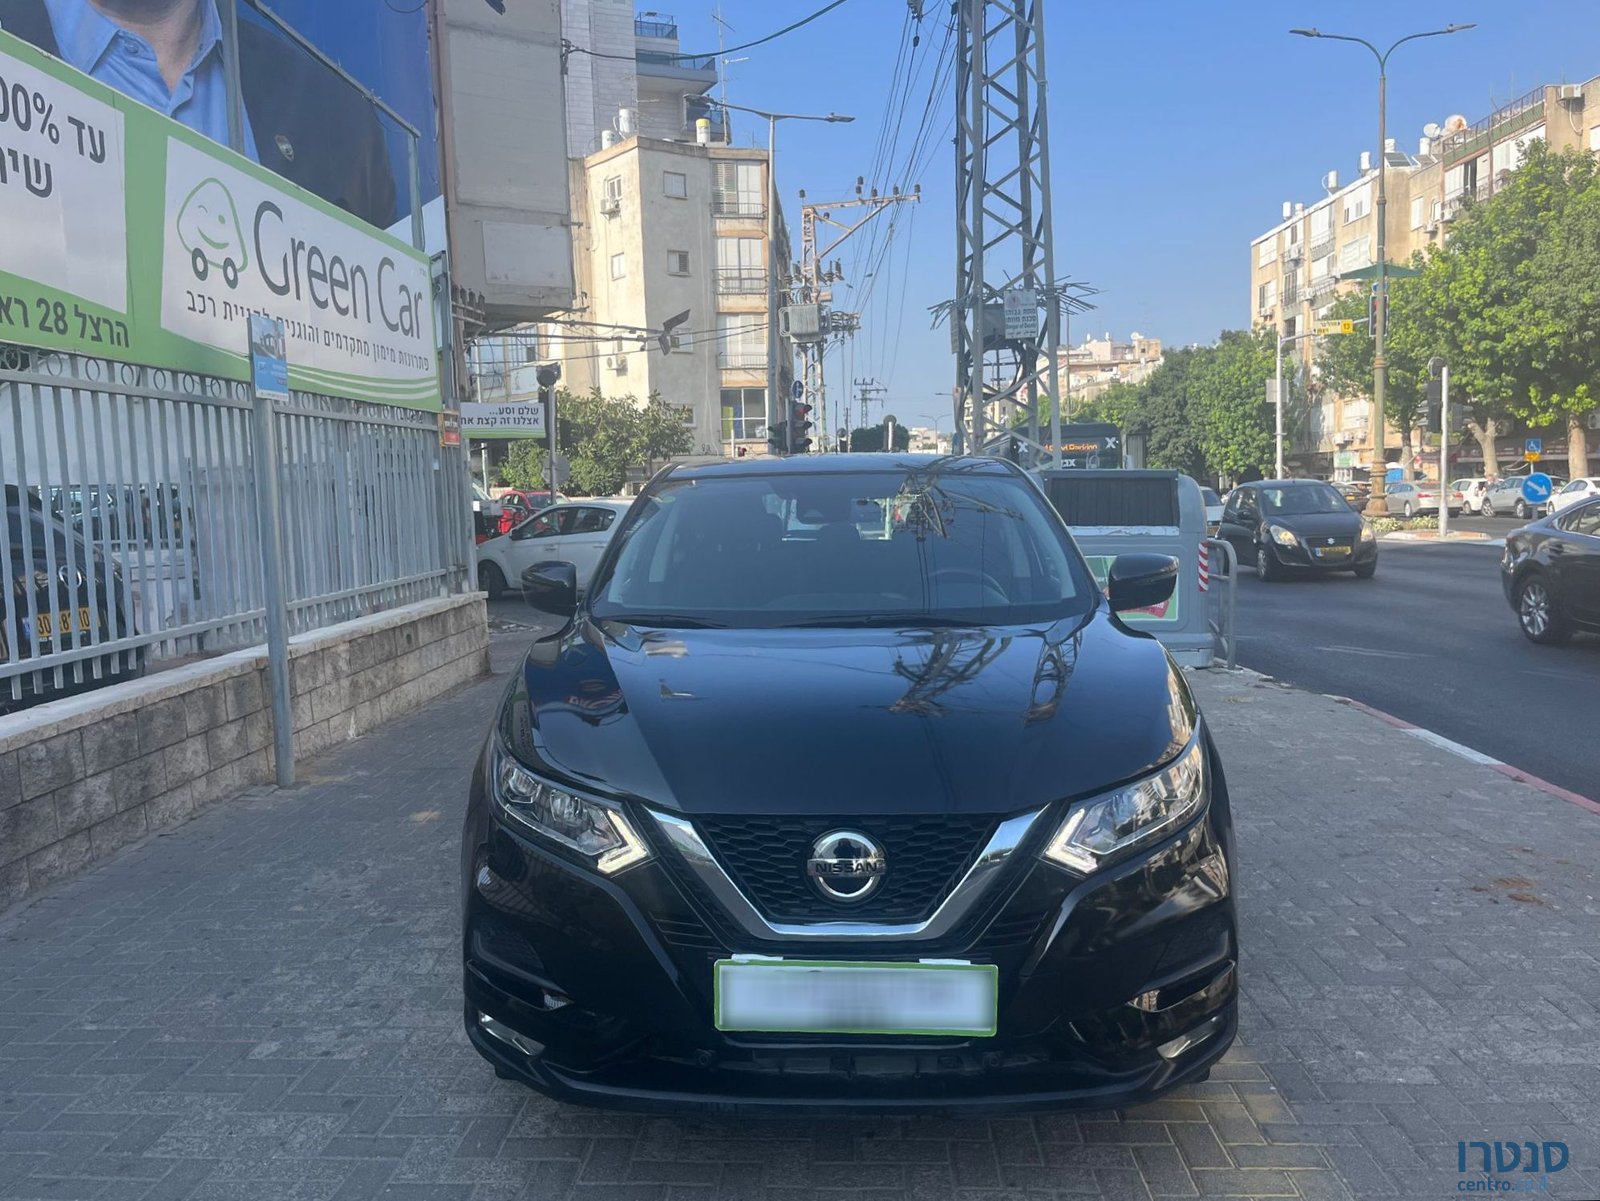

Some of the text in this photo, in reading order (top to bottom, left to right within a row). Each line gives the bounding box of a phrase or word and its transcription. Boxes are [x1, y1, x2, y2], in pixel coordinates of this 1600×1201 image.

[67, 115, 106, 164] עד
[253, 200, 423, 340] Green Car
[186, 289, 217, 318] רכב
[36, 297, 69, 336] 28
[73, 303, 130, 348] הרצל
[323, 329, 370, 357] מתקדמים
[372, 342, 396, 363] מימון
[399, 350, 430, 371] פתרונות
[500, 416, 511, 425] זה
[513, 415, 540, 425] אצלנו
[518, 406, 539, 415] שלם
[476, 416, 497, 427] קצת
[814, 862, 878, 873] NISSAN
